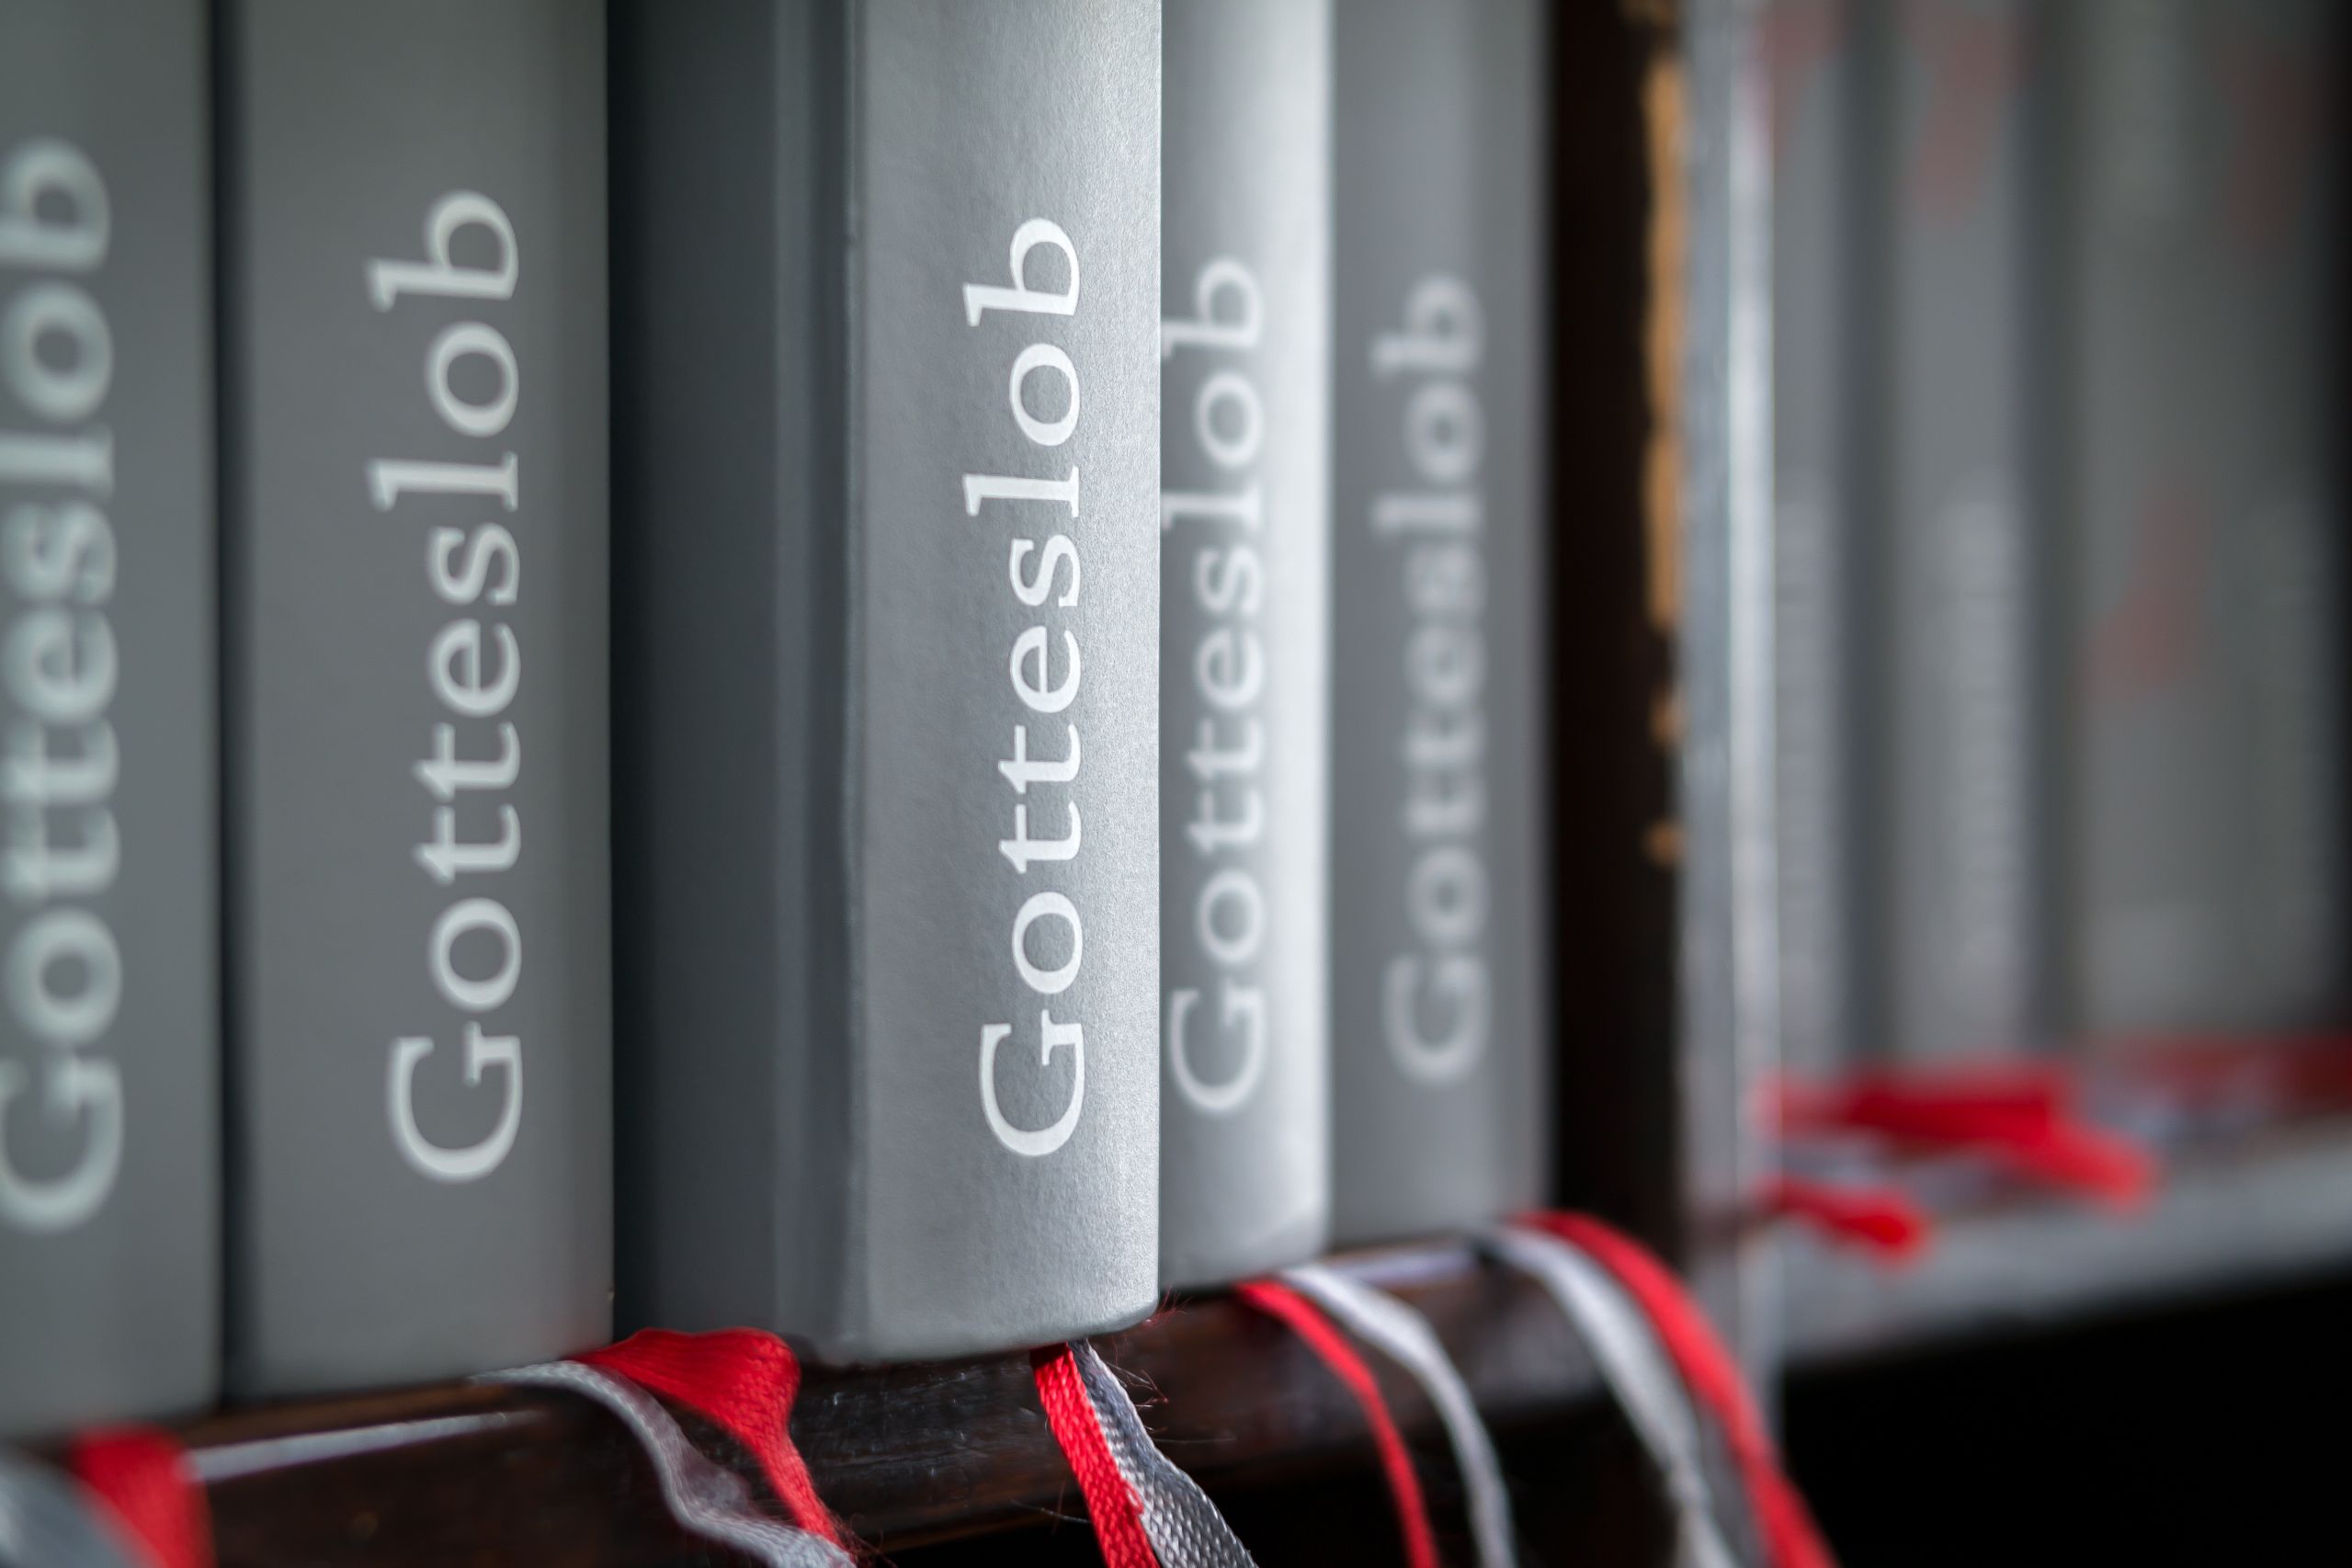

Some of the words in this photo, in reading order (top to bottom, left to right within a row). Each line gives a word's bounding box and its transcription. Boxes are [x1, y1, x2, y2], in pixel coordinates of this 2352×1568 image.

[367, 190, 524, 1183] Gotteslob
[962, 217, 1085, 1156] Gotteslob
[1161, 259, 1267, 1112] Gotteslob
